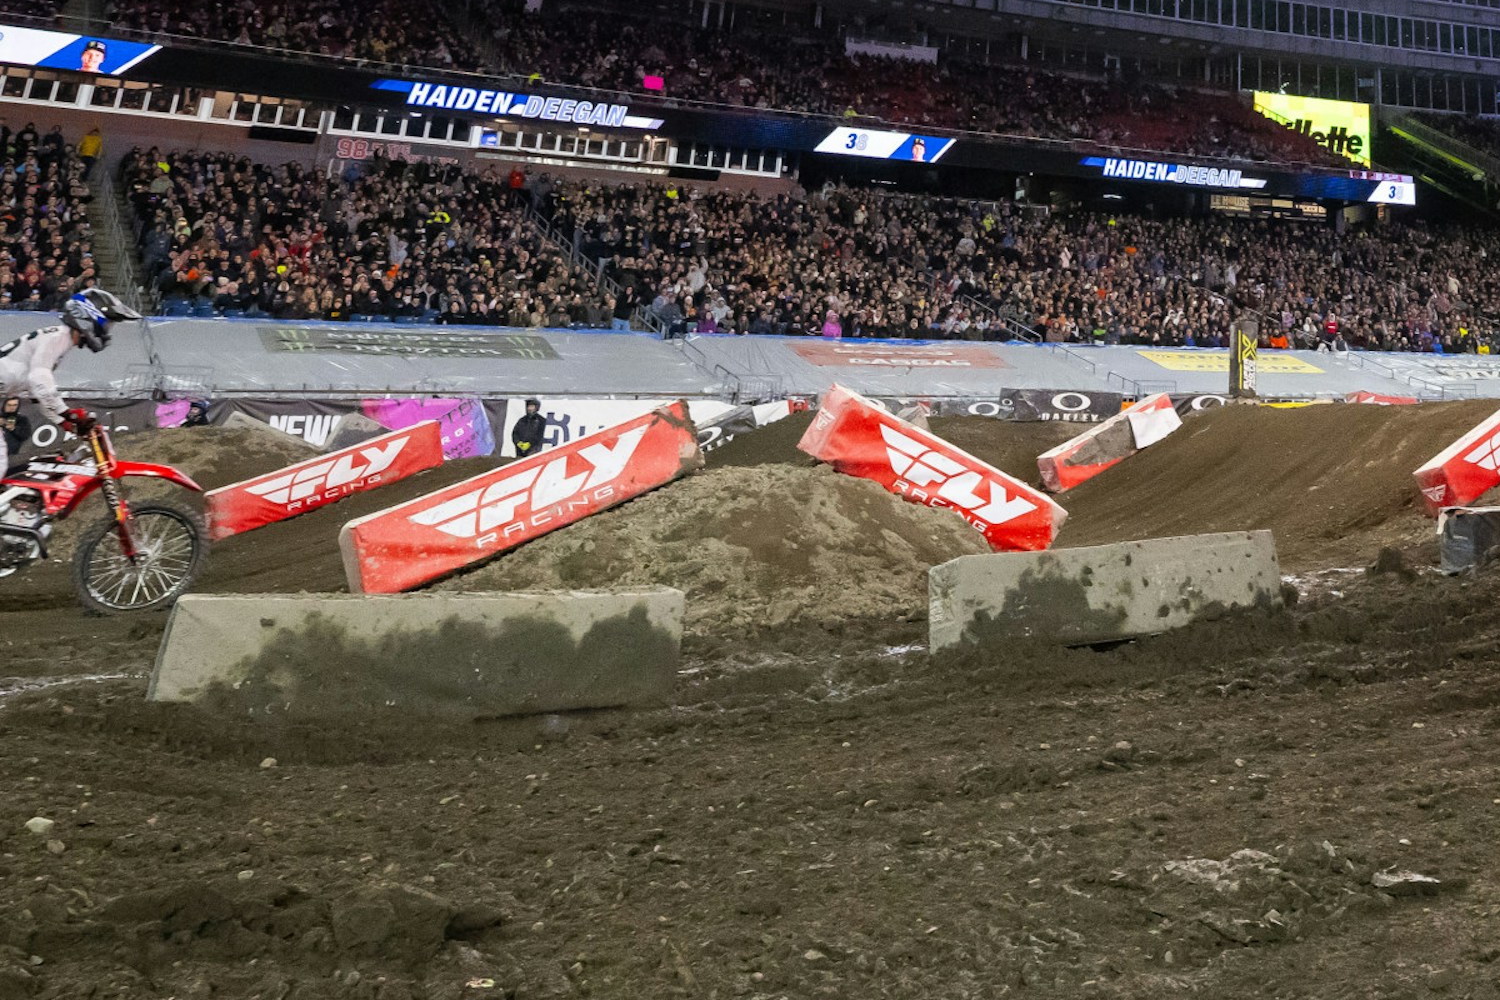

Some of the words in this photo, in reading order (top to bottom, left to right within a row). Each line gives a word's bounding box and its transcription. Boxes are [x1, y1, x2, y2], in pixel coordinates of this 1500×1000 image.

[406, 83, 513, 115] HAIDEN
[522, 95, 628, 127] DEEGAN
[1103, 158, 1168, 181] HAIDEN
[1175, 165, 1243, 188] DEEGAN
[244, 436, 411, 504] FLY
[287, 474, 382, 511] RACING
[407, 424, 650, 538] FLY
[879, 423, 1039, 524] FLY
[476, 485, 615, 548] RACING
